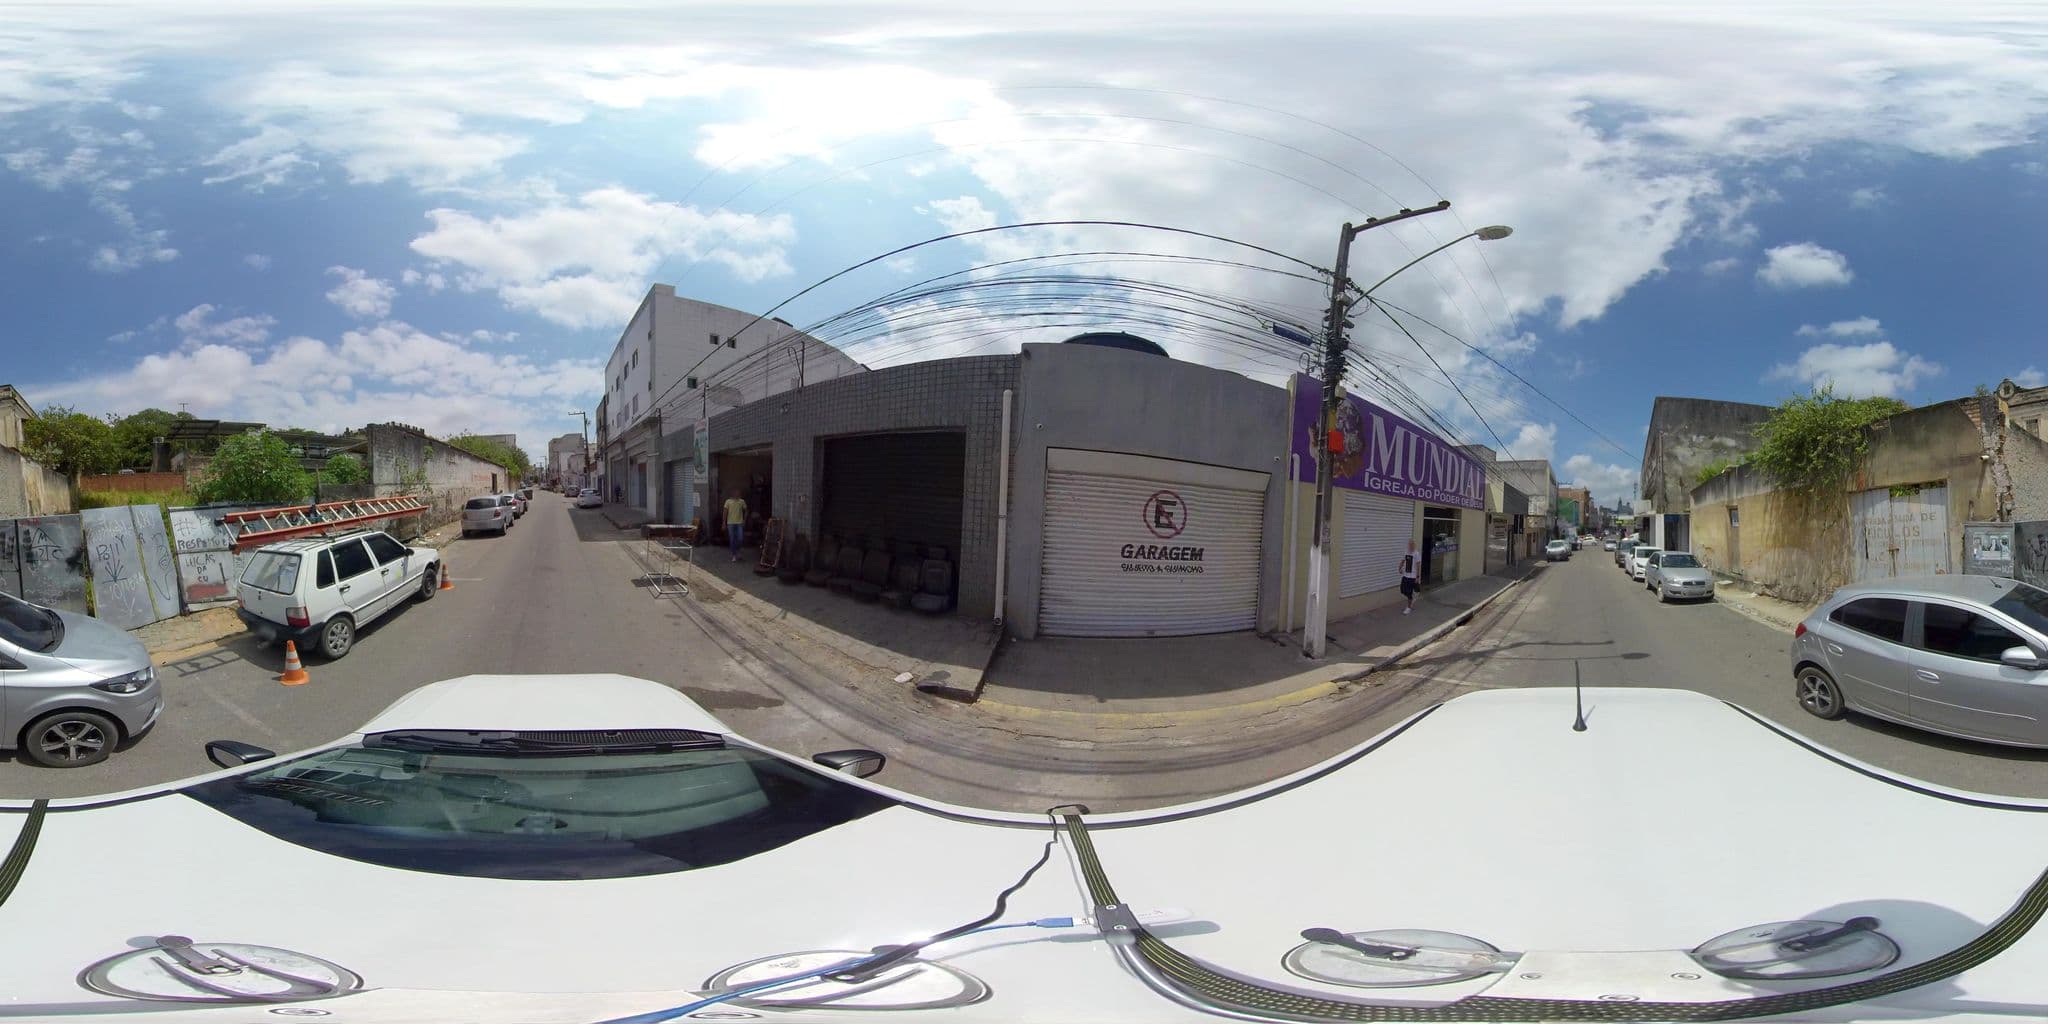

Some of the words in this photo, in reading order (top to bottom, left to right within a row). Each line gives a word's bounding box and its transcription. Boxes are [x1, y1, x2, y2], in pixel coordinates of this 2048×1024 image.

[1366, 412, 1484, 501] MUNDIAL
[1365, 472, 1416, 496] IGREJA
[1417, 487, 1433, 499] DO
[1434, 489, 1460, 505] PODER
[1920, 511, 1937, 521] DE
[1121, 543, 1204, 561] GARAGEM
[1121, 563, 1155, 573] SUJEITO
[1164, 564, 1204, 574] GUINCHO
